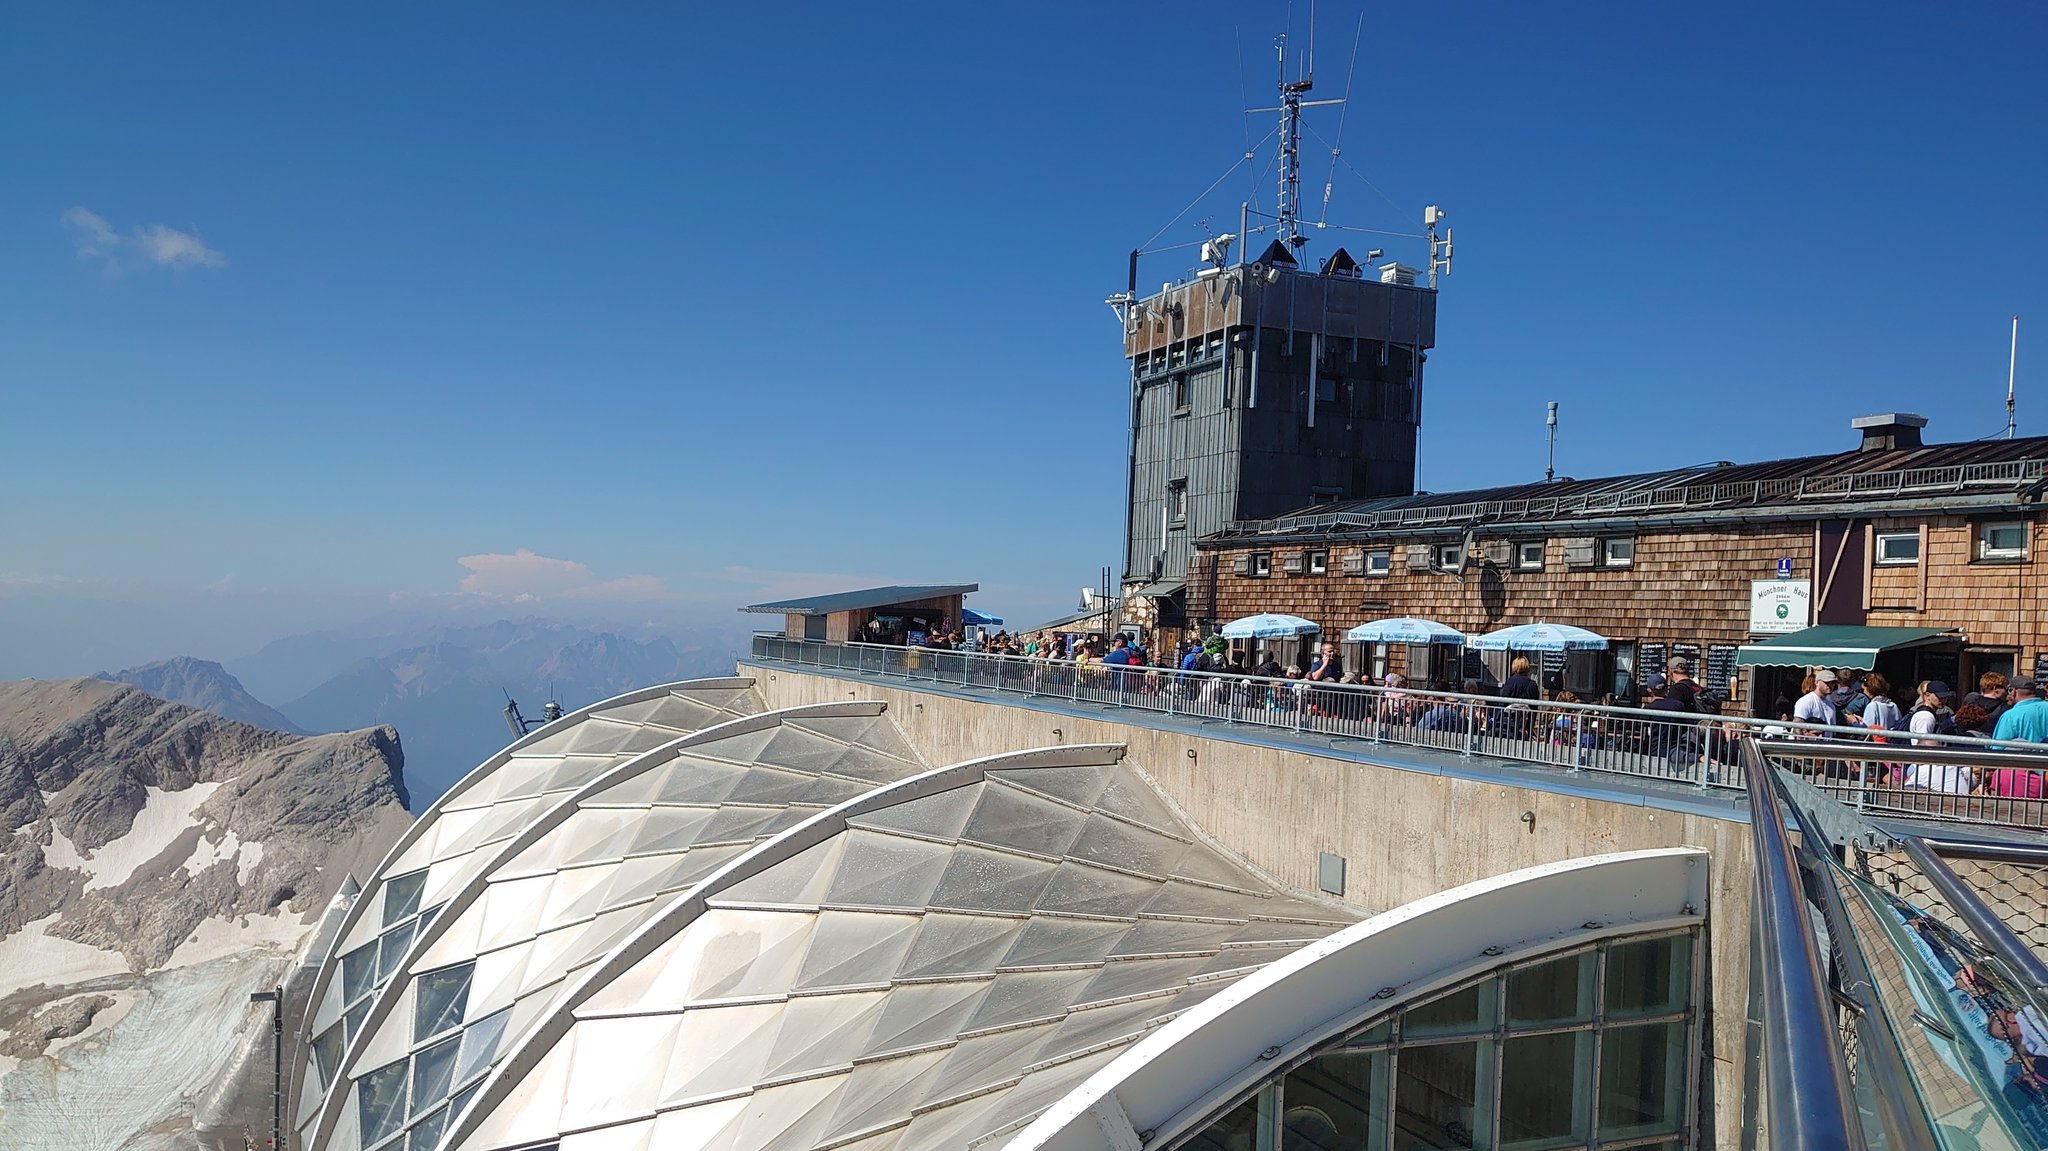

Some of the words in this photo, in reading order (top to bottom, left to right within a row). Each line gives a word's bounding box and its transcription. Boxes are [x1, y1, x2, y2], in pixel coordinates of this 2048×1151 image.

[1782, 559, 1786, 569] 1
[1757, 585, 1787, 599] Münchner
[1793, 586, 1808, 599] Haus
